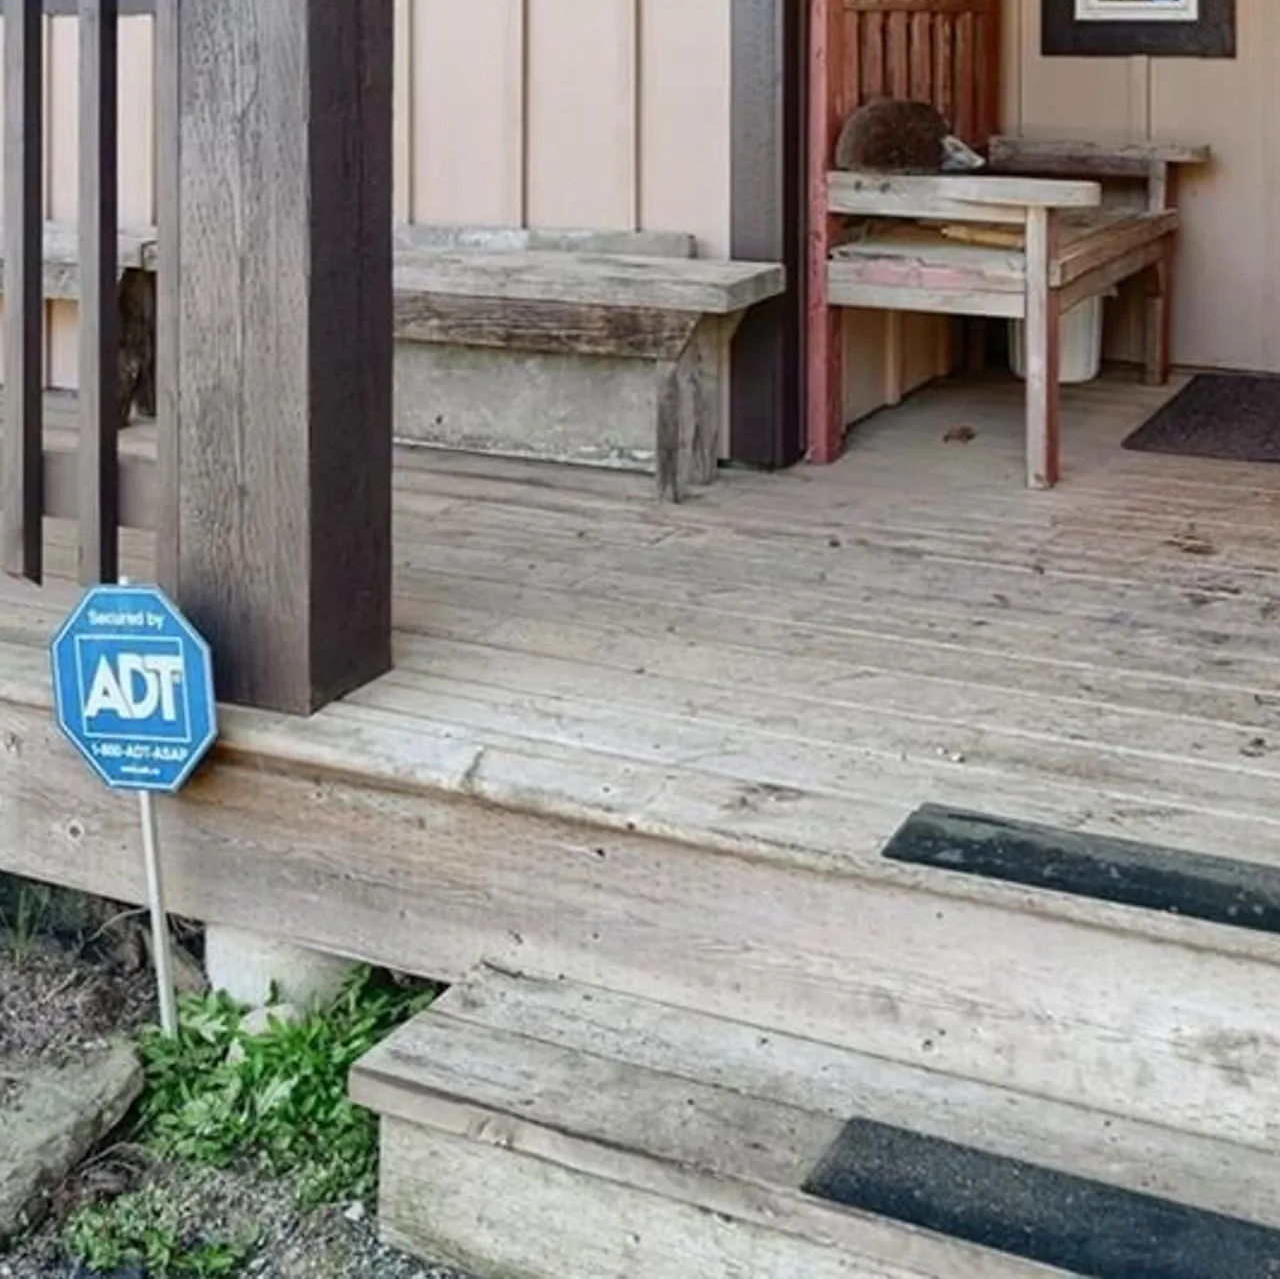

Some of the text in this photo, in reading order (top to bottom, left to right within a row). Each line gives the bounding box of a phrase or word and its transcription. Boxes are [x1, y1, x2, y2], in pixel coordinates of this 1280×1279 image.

[88, 609, 165, 629] Secured by
[84, 653, 183, 721] ADT
